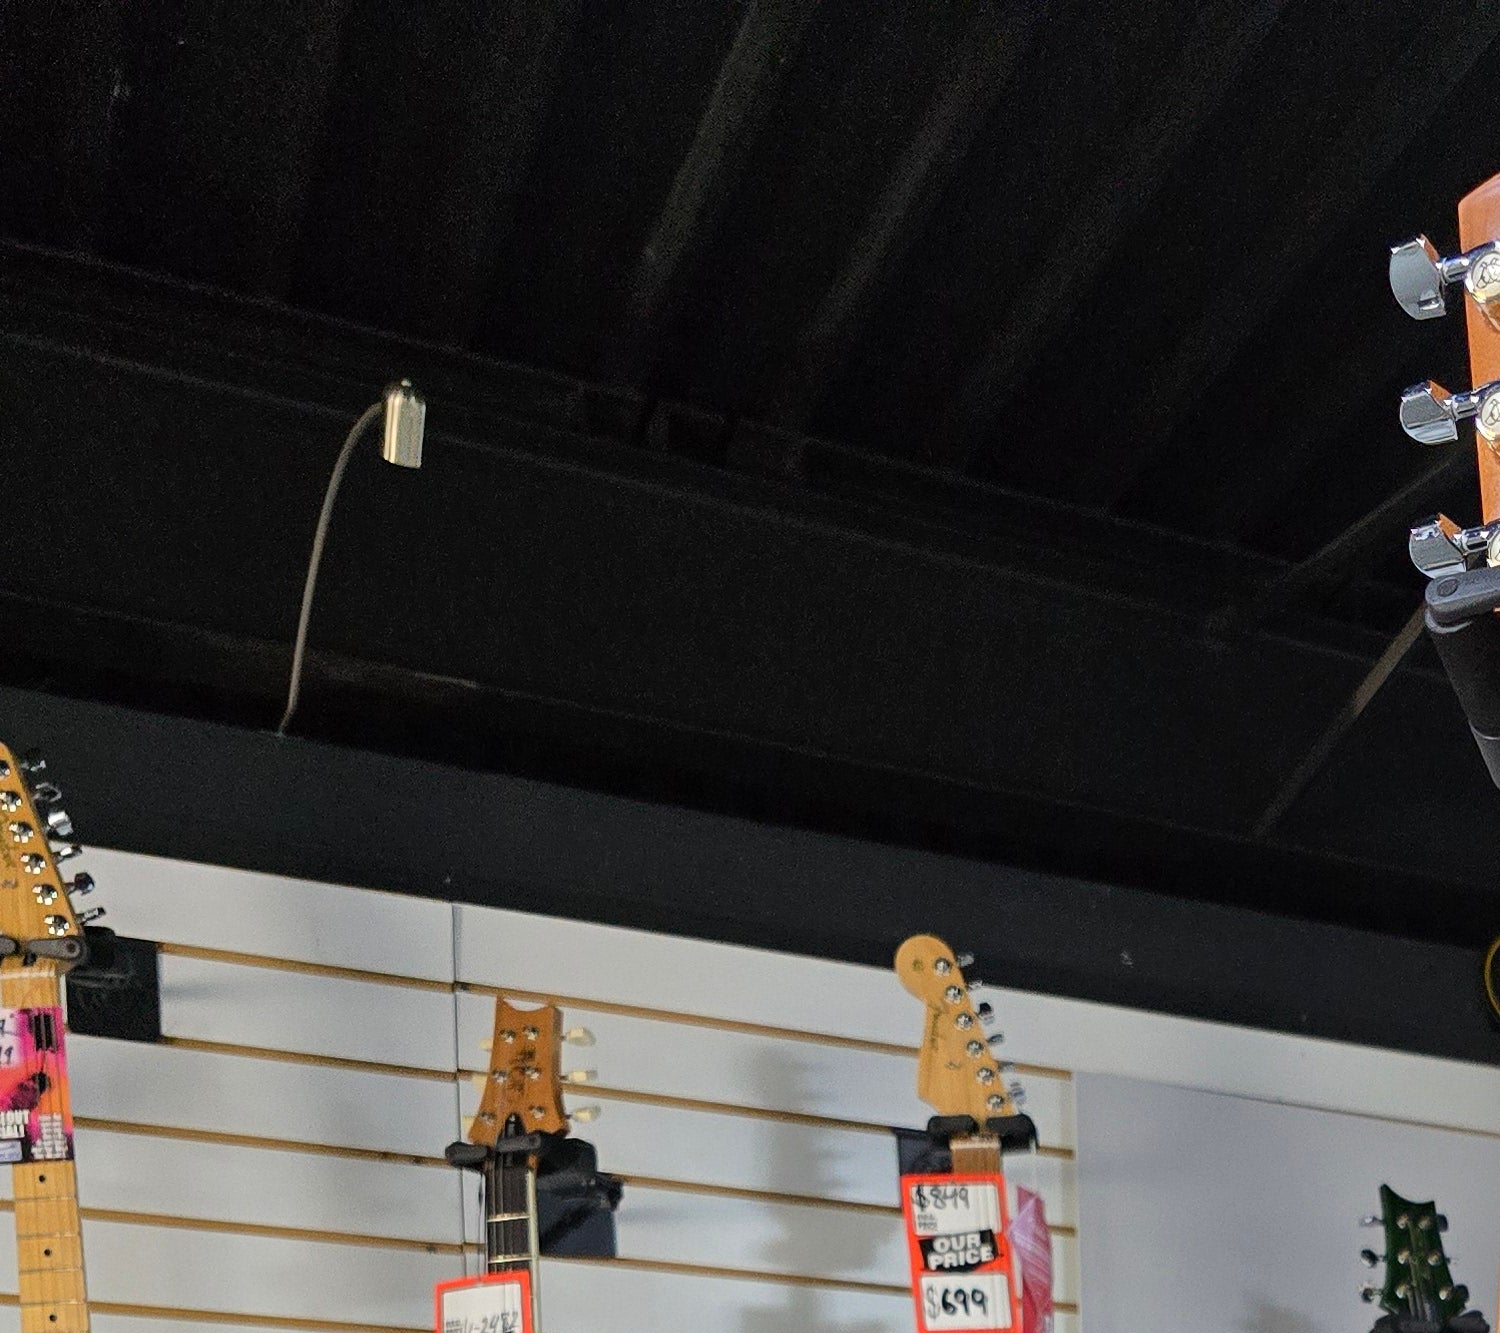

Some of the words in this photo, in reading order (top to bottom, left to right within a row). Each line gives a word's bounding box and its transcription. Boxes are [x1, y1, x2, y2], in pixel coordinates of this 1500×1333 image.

[932, 1233, 981, 1252] OUR
[927, 1246, 994, 1271] PRICE
[926, 1285, 988, 1320] $699
